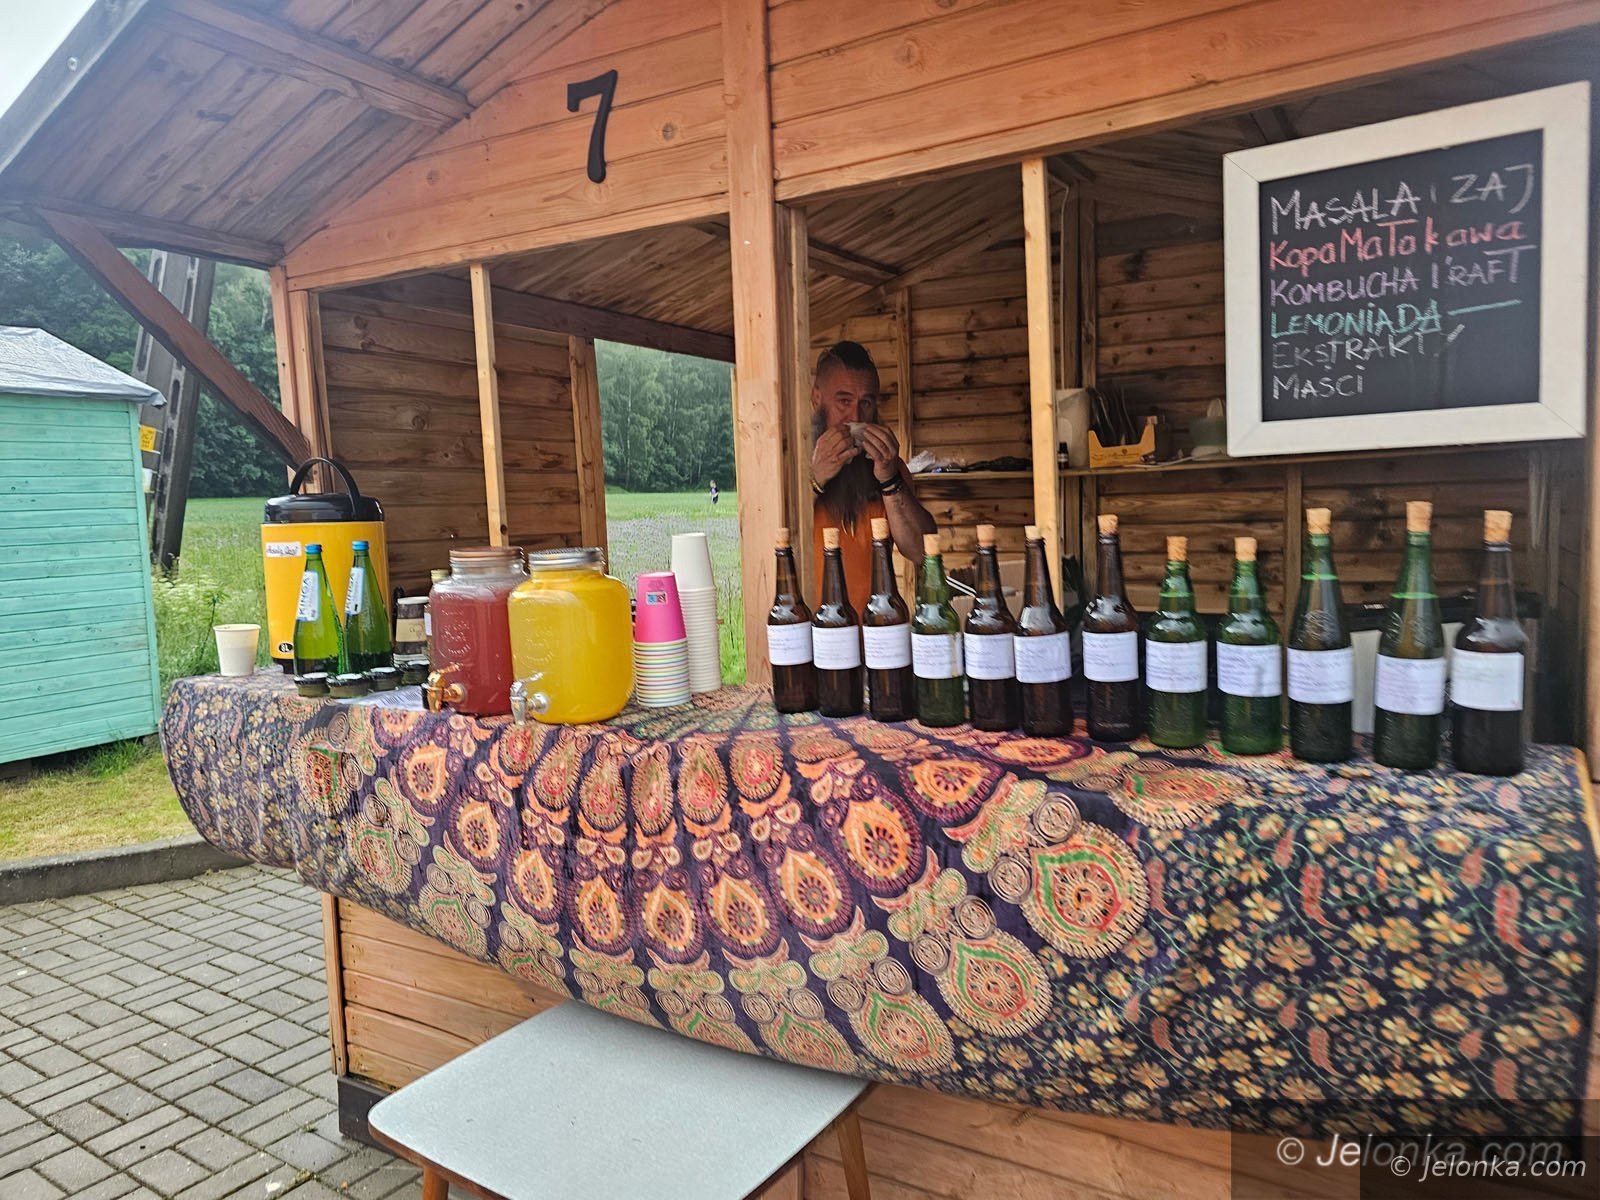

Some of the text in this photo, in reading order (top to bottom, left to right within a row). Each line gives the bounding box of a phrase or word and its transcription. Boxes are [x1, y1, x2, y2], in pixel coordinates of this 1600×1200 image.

[567, 69, 618, 184] 7
[1270, 181, 1421, 235] MASALA
[1270, 266, 1420, 307] KOMBUCHA
